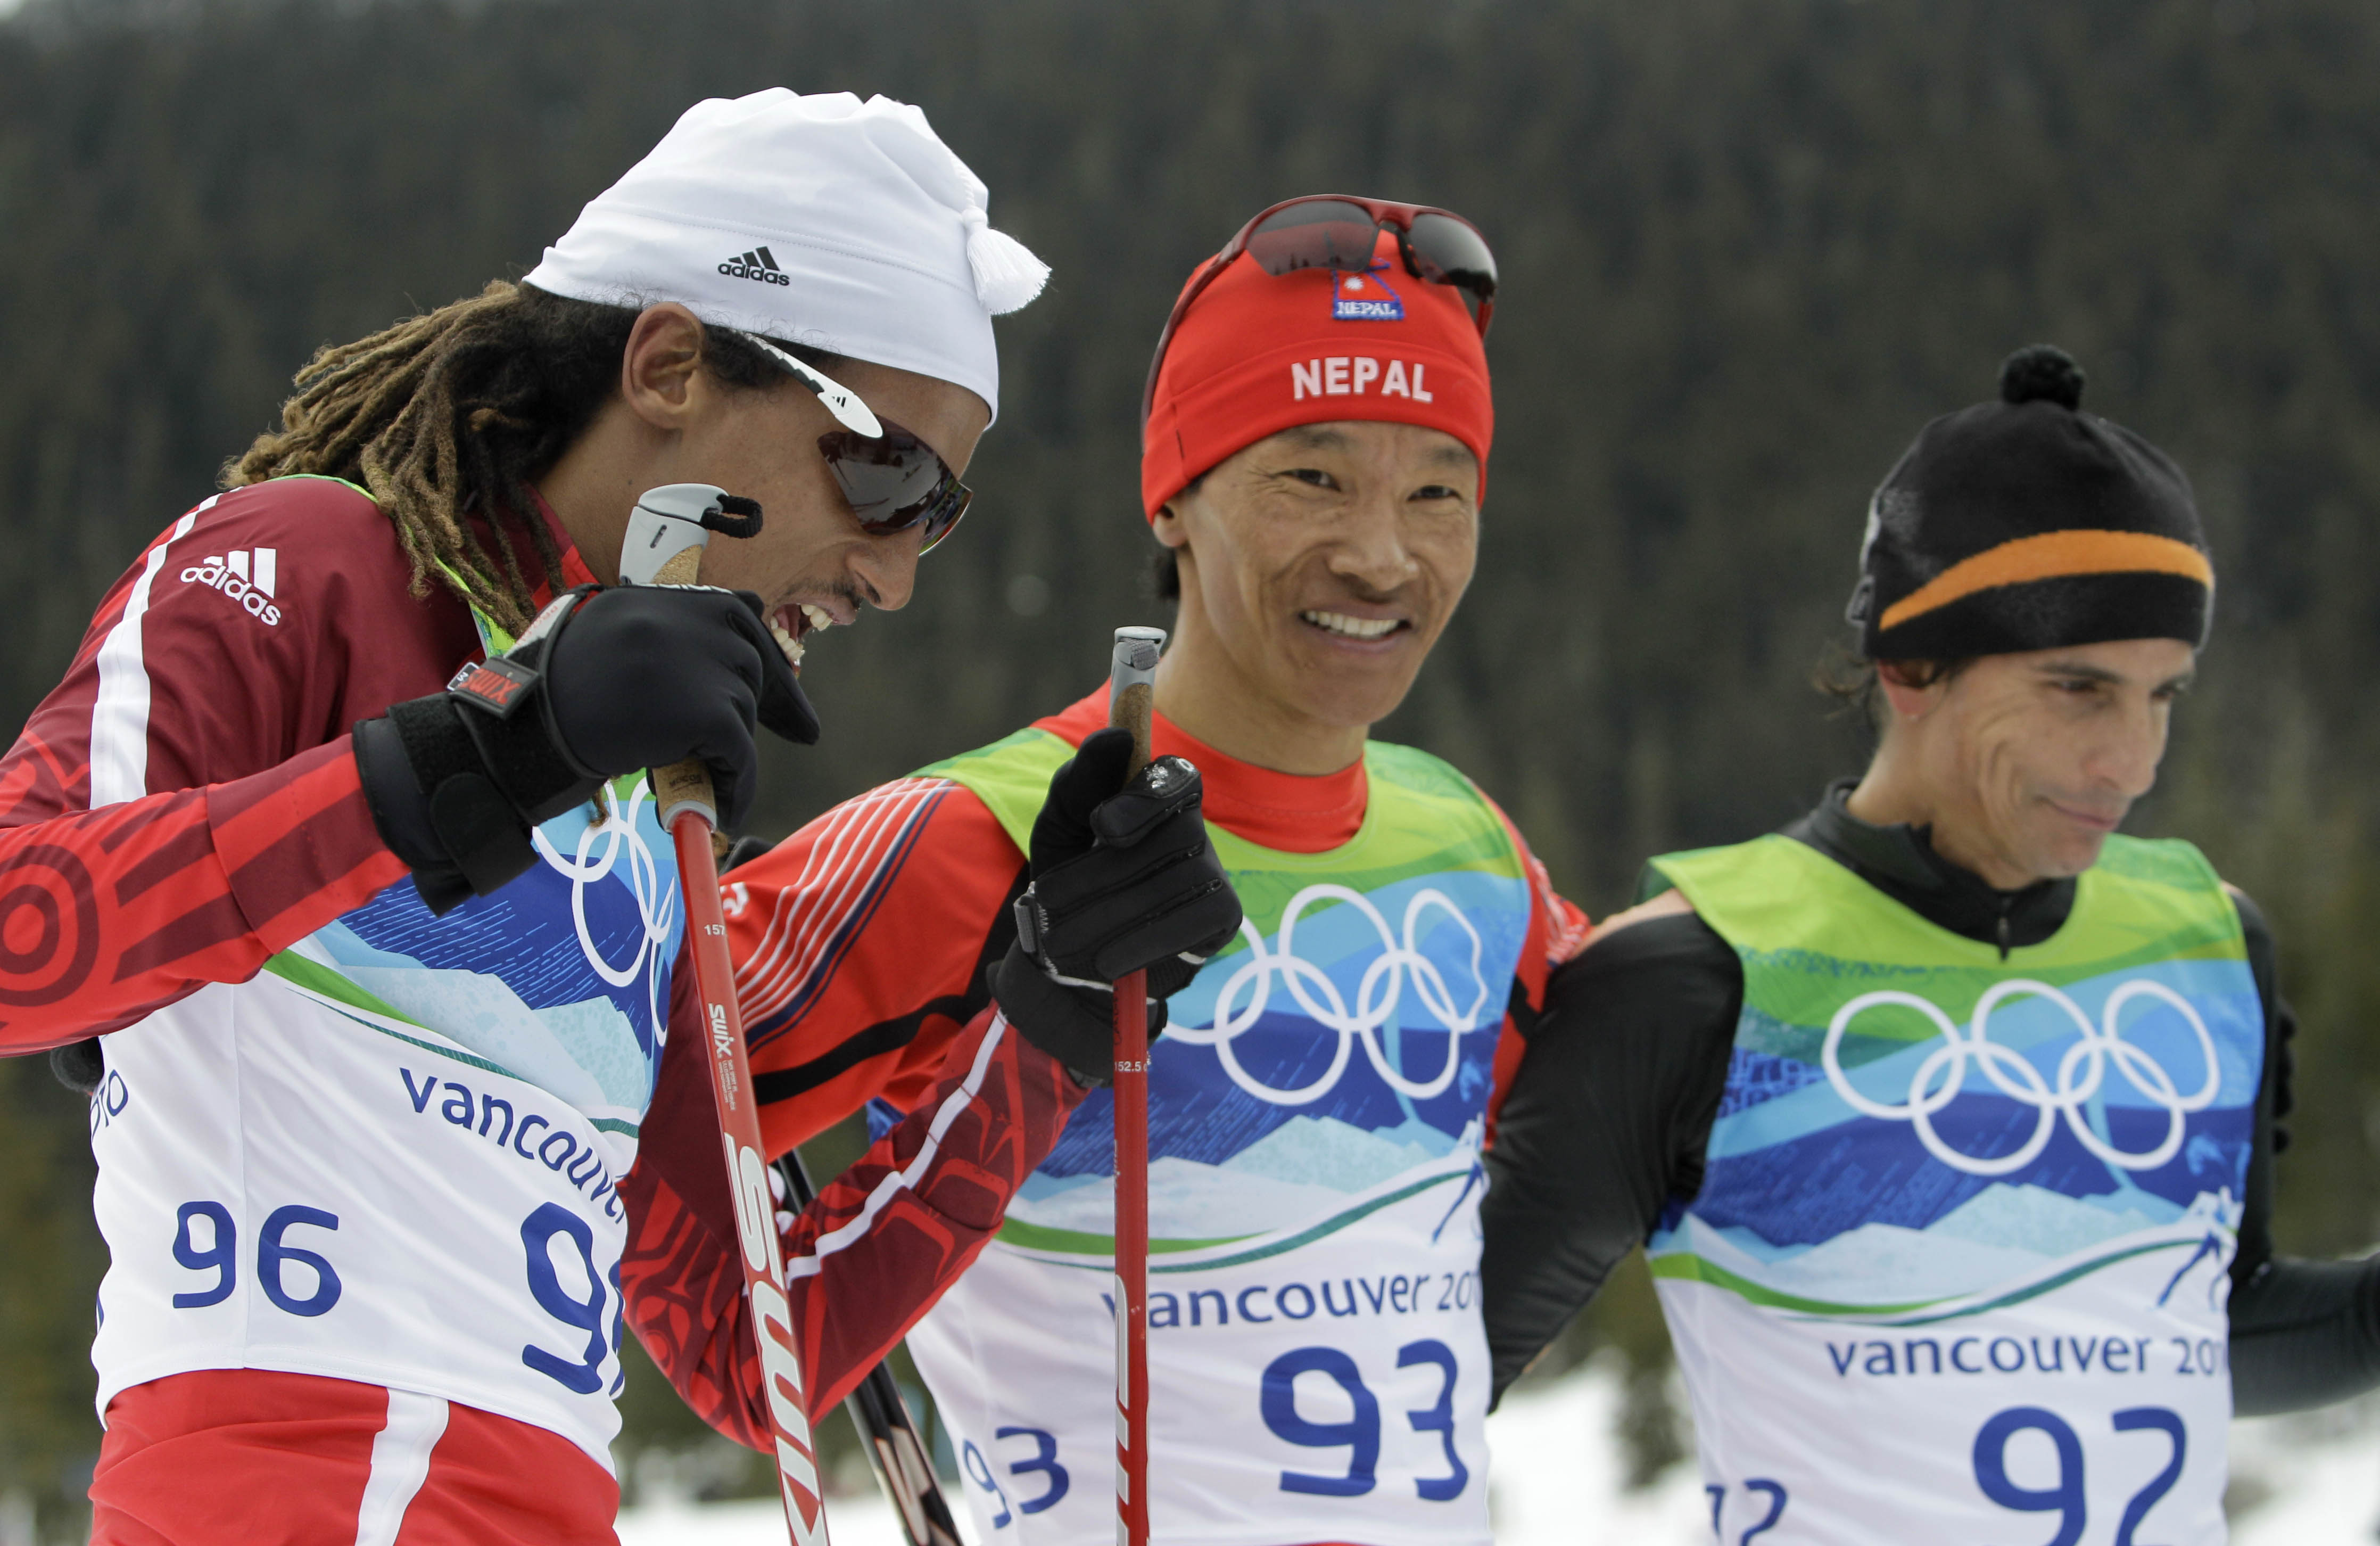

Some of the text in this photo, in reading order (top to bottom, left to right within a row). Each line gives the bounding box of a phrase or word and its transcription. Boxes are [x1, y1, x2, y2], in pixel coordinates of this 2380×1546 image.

[718, 263, 790, 286] adidas
[1337, 301, 1398, 315] NEPAL
[1292, 356, 1433, 403] NEPAL
[180, 565, 281, 626] adidas
[704, 924, 725, 936] 157
[1114, 1061, 1142, 1072] 152.5
[172, 1200, 342, 1317] 96
[520, 1200, 625, 1396] 9
[1827, 1335, 2150, 1376] vancouver
[1260, 1338, 1469, 1502] 93
[962, 1426, 1070, 1530] 93
[1971, 1407, 2187, 1546] 92
